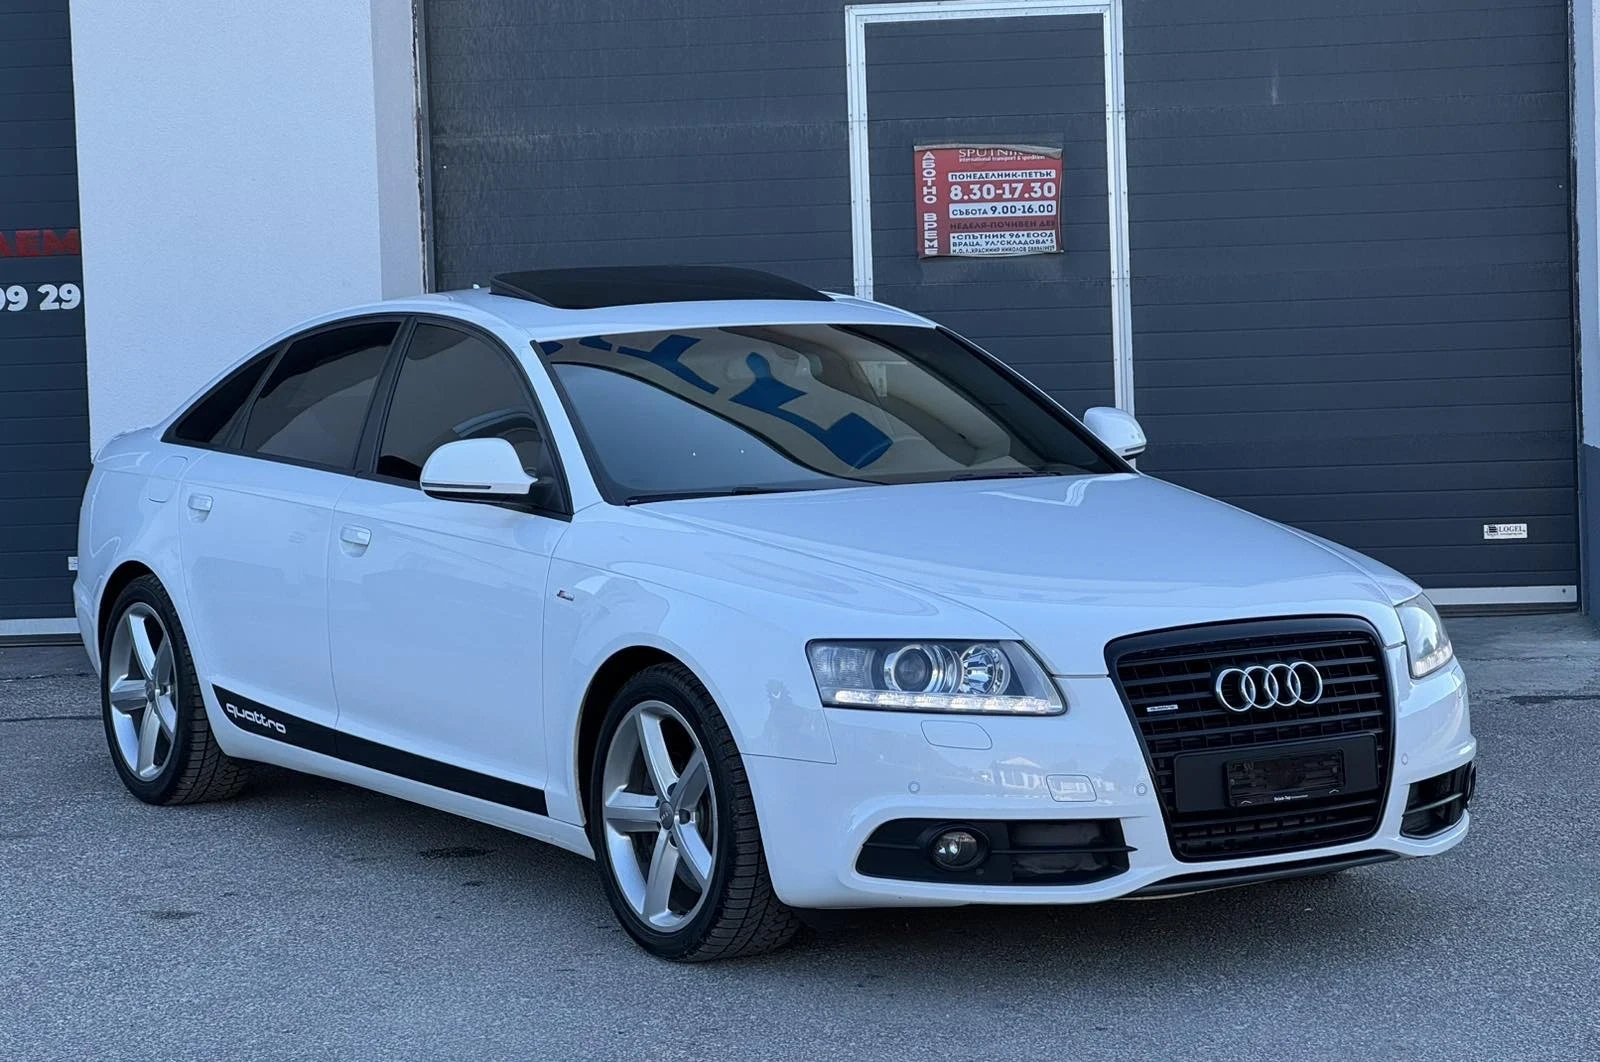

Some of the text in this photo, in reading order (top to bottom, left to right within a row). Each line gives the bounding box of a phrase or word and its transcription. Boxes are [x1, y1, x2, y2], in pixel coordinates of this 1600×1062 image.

[951, 171, 1052, 181] ПОНЕДЕЛНИК-ПЕТЪК
[950, 182, 1056, 201] 8.30-17.30
[952, 204, 1053, 216] СЪБОТА 9.00-16.00
[37, 283, 80, 310] 29
[225, 702, 287, 734] quattro
